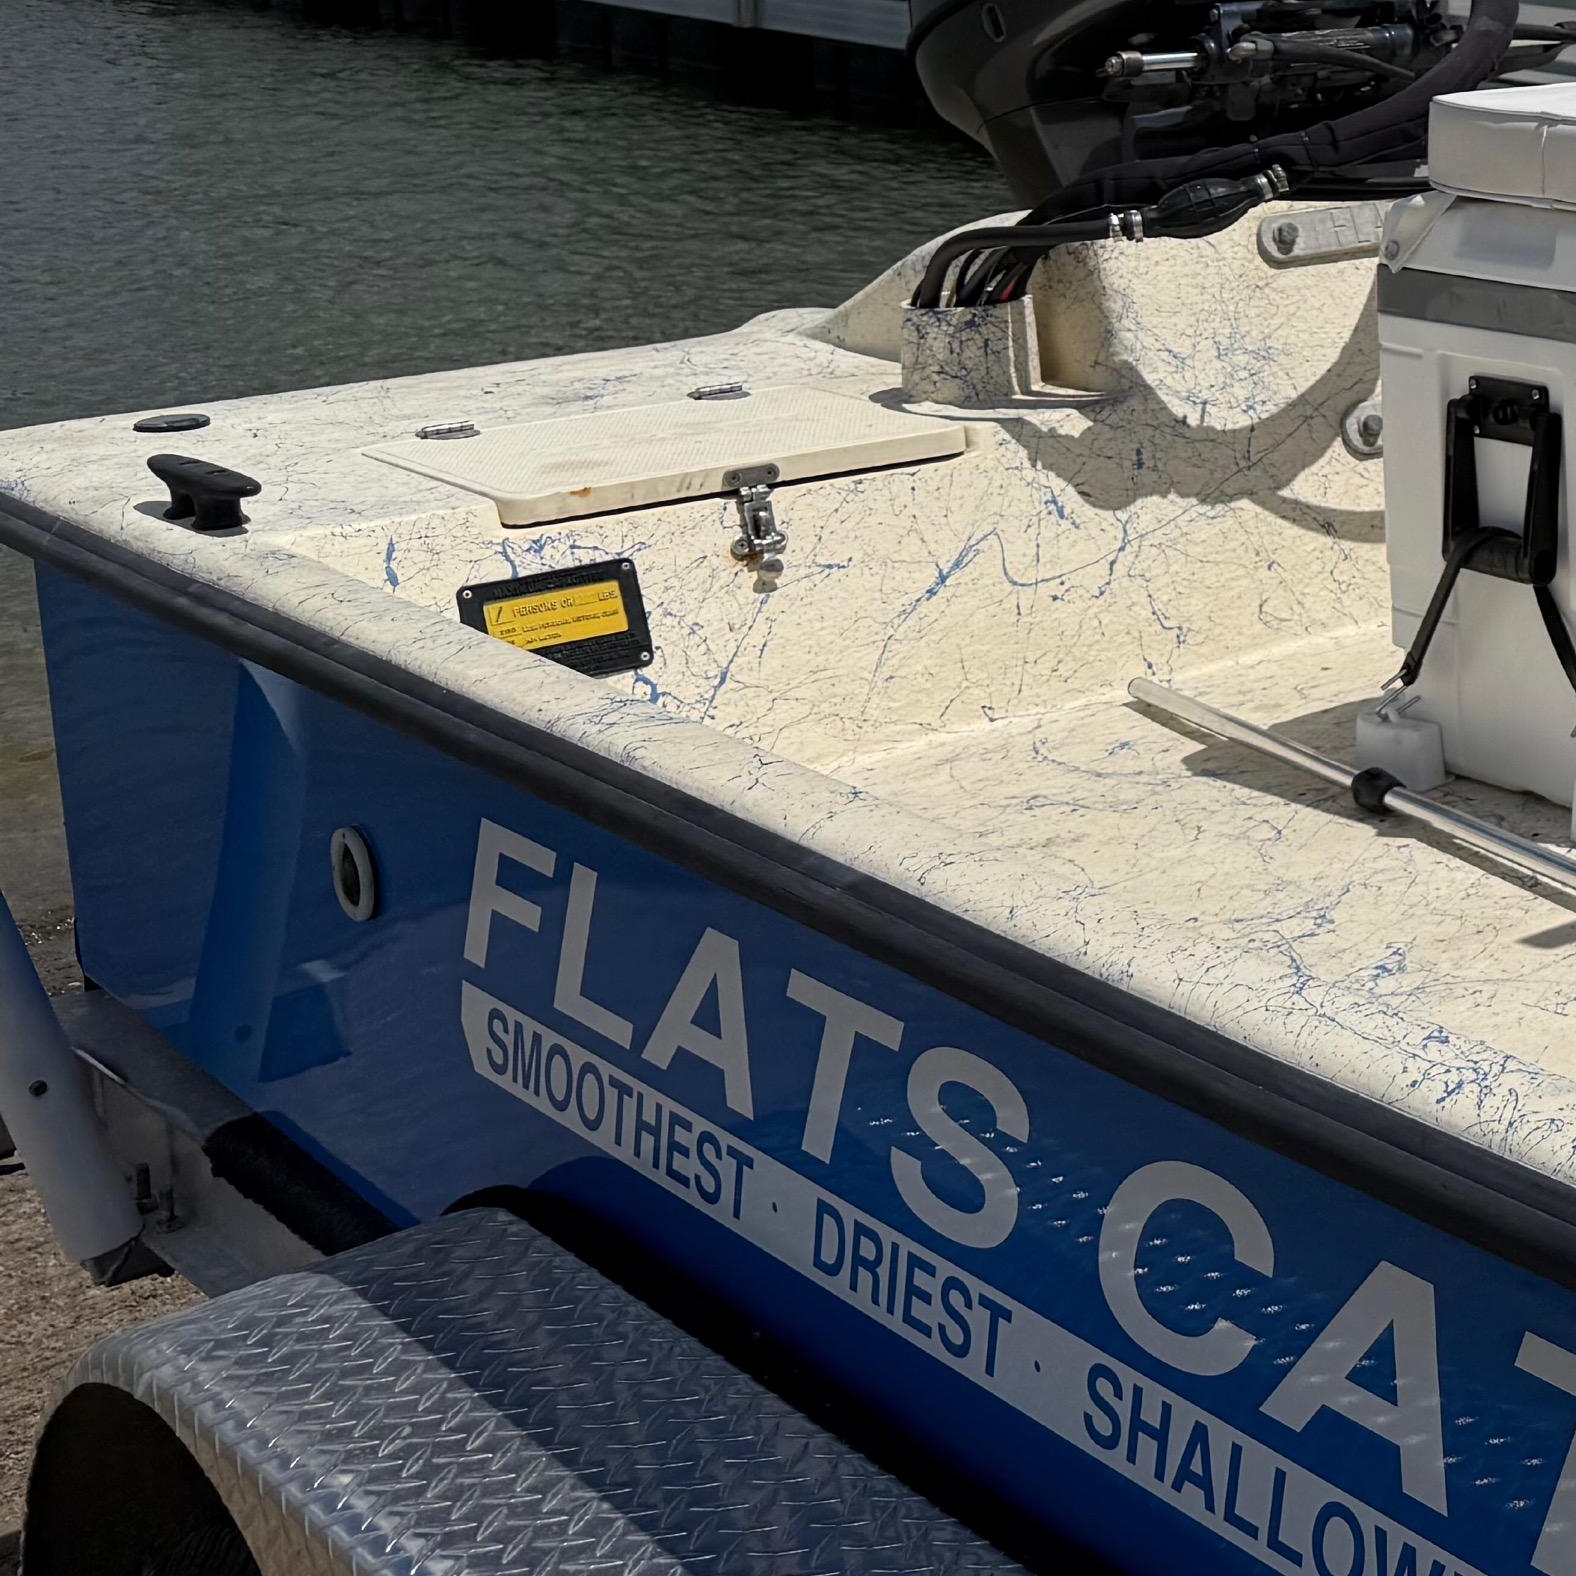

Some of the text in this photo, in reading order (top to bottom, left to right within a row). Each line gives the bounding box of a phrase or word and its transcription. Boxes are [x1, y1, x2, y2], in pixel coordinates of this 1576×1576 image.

[463, 817, 1030, 1249] FLATS
[486, 1007, 754, 1221] SMOOTHEST
[812, 1197, 1013, 1378] DRIEST
